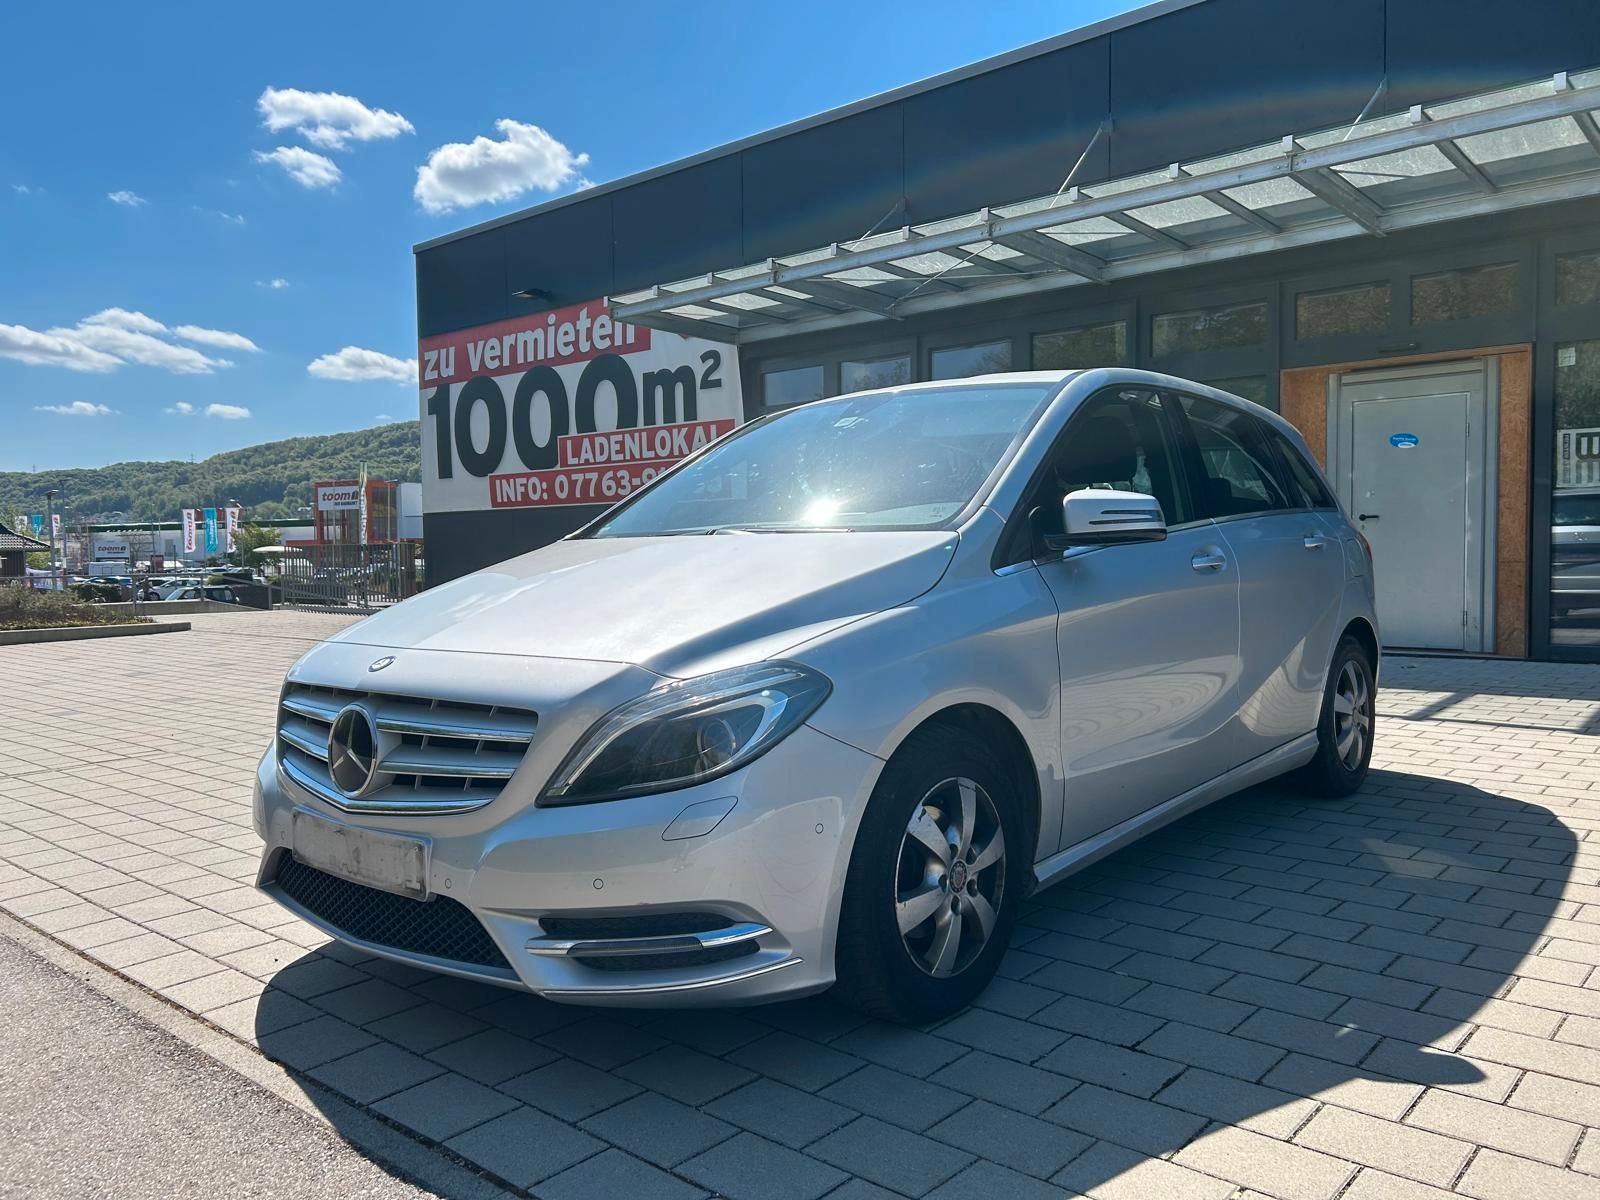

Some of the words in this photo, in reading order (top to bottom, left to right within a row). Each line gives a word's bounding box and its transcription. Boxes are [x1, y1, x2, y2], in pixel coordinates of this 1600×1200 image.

[424, 346, 455, 382] zu
[322, 492, 351, 501] toom
[495, 475, 548, 503] INFO:
